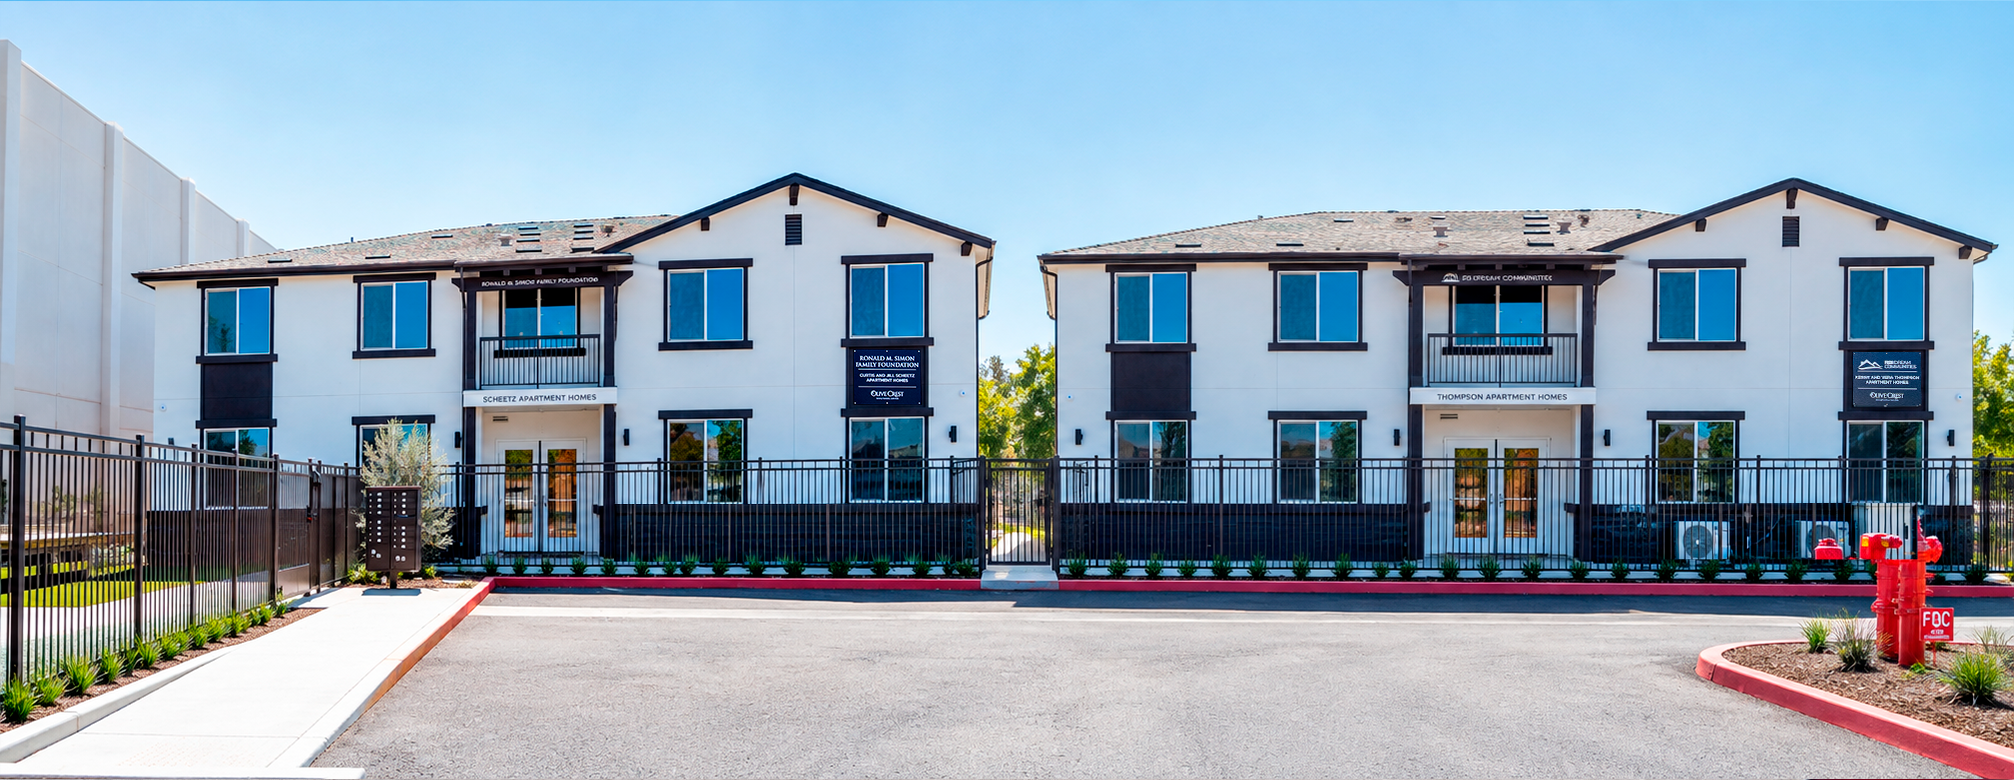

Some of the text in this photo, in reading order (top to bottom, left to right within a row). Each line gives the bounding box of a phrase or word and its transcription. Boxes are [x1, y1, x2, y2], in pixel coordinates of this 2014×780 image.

[482, 393, 597, 403] SCHEETZ APARTMENT HOMES
[1437, 393, 1568, 401] THOMPSON APARTMENT HOMES
[1923, 611, 1951, 628] FDC
